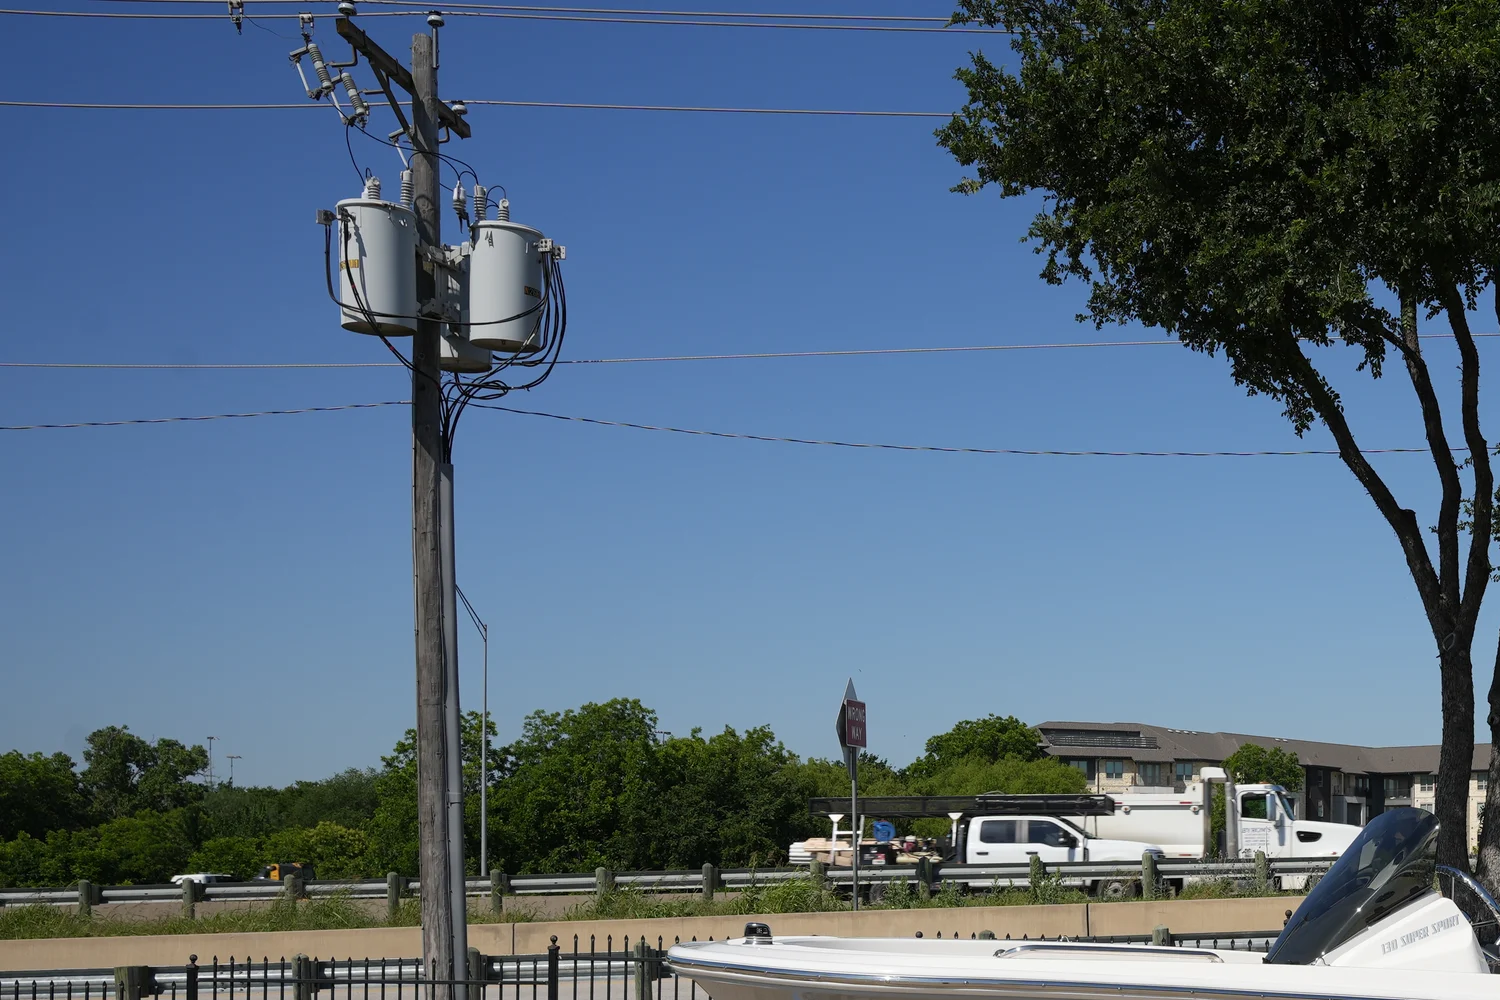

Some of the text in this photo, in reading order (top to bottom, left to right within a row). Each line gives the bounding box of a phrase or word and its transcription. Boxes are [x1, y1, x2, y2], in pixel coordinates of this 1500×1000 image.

[848, 706, 865, 723] WRONG
[851, 726, 862, 740] WAY
[1381, 914, 1460, 955] 130 SUPER SPORT
